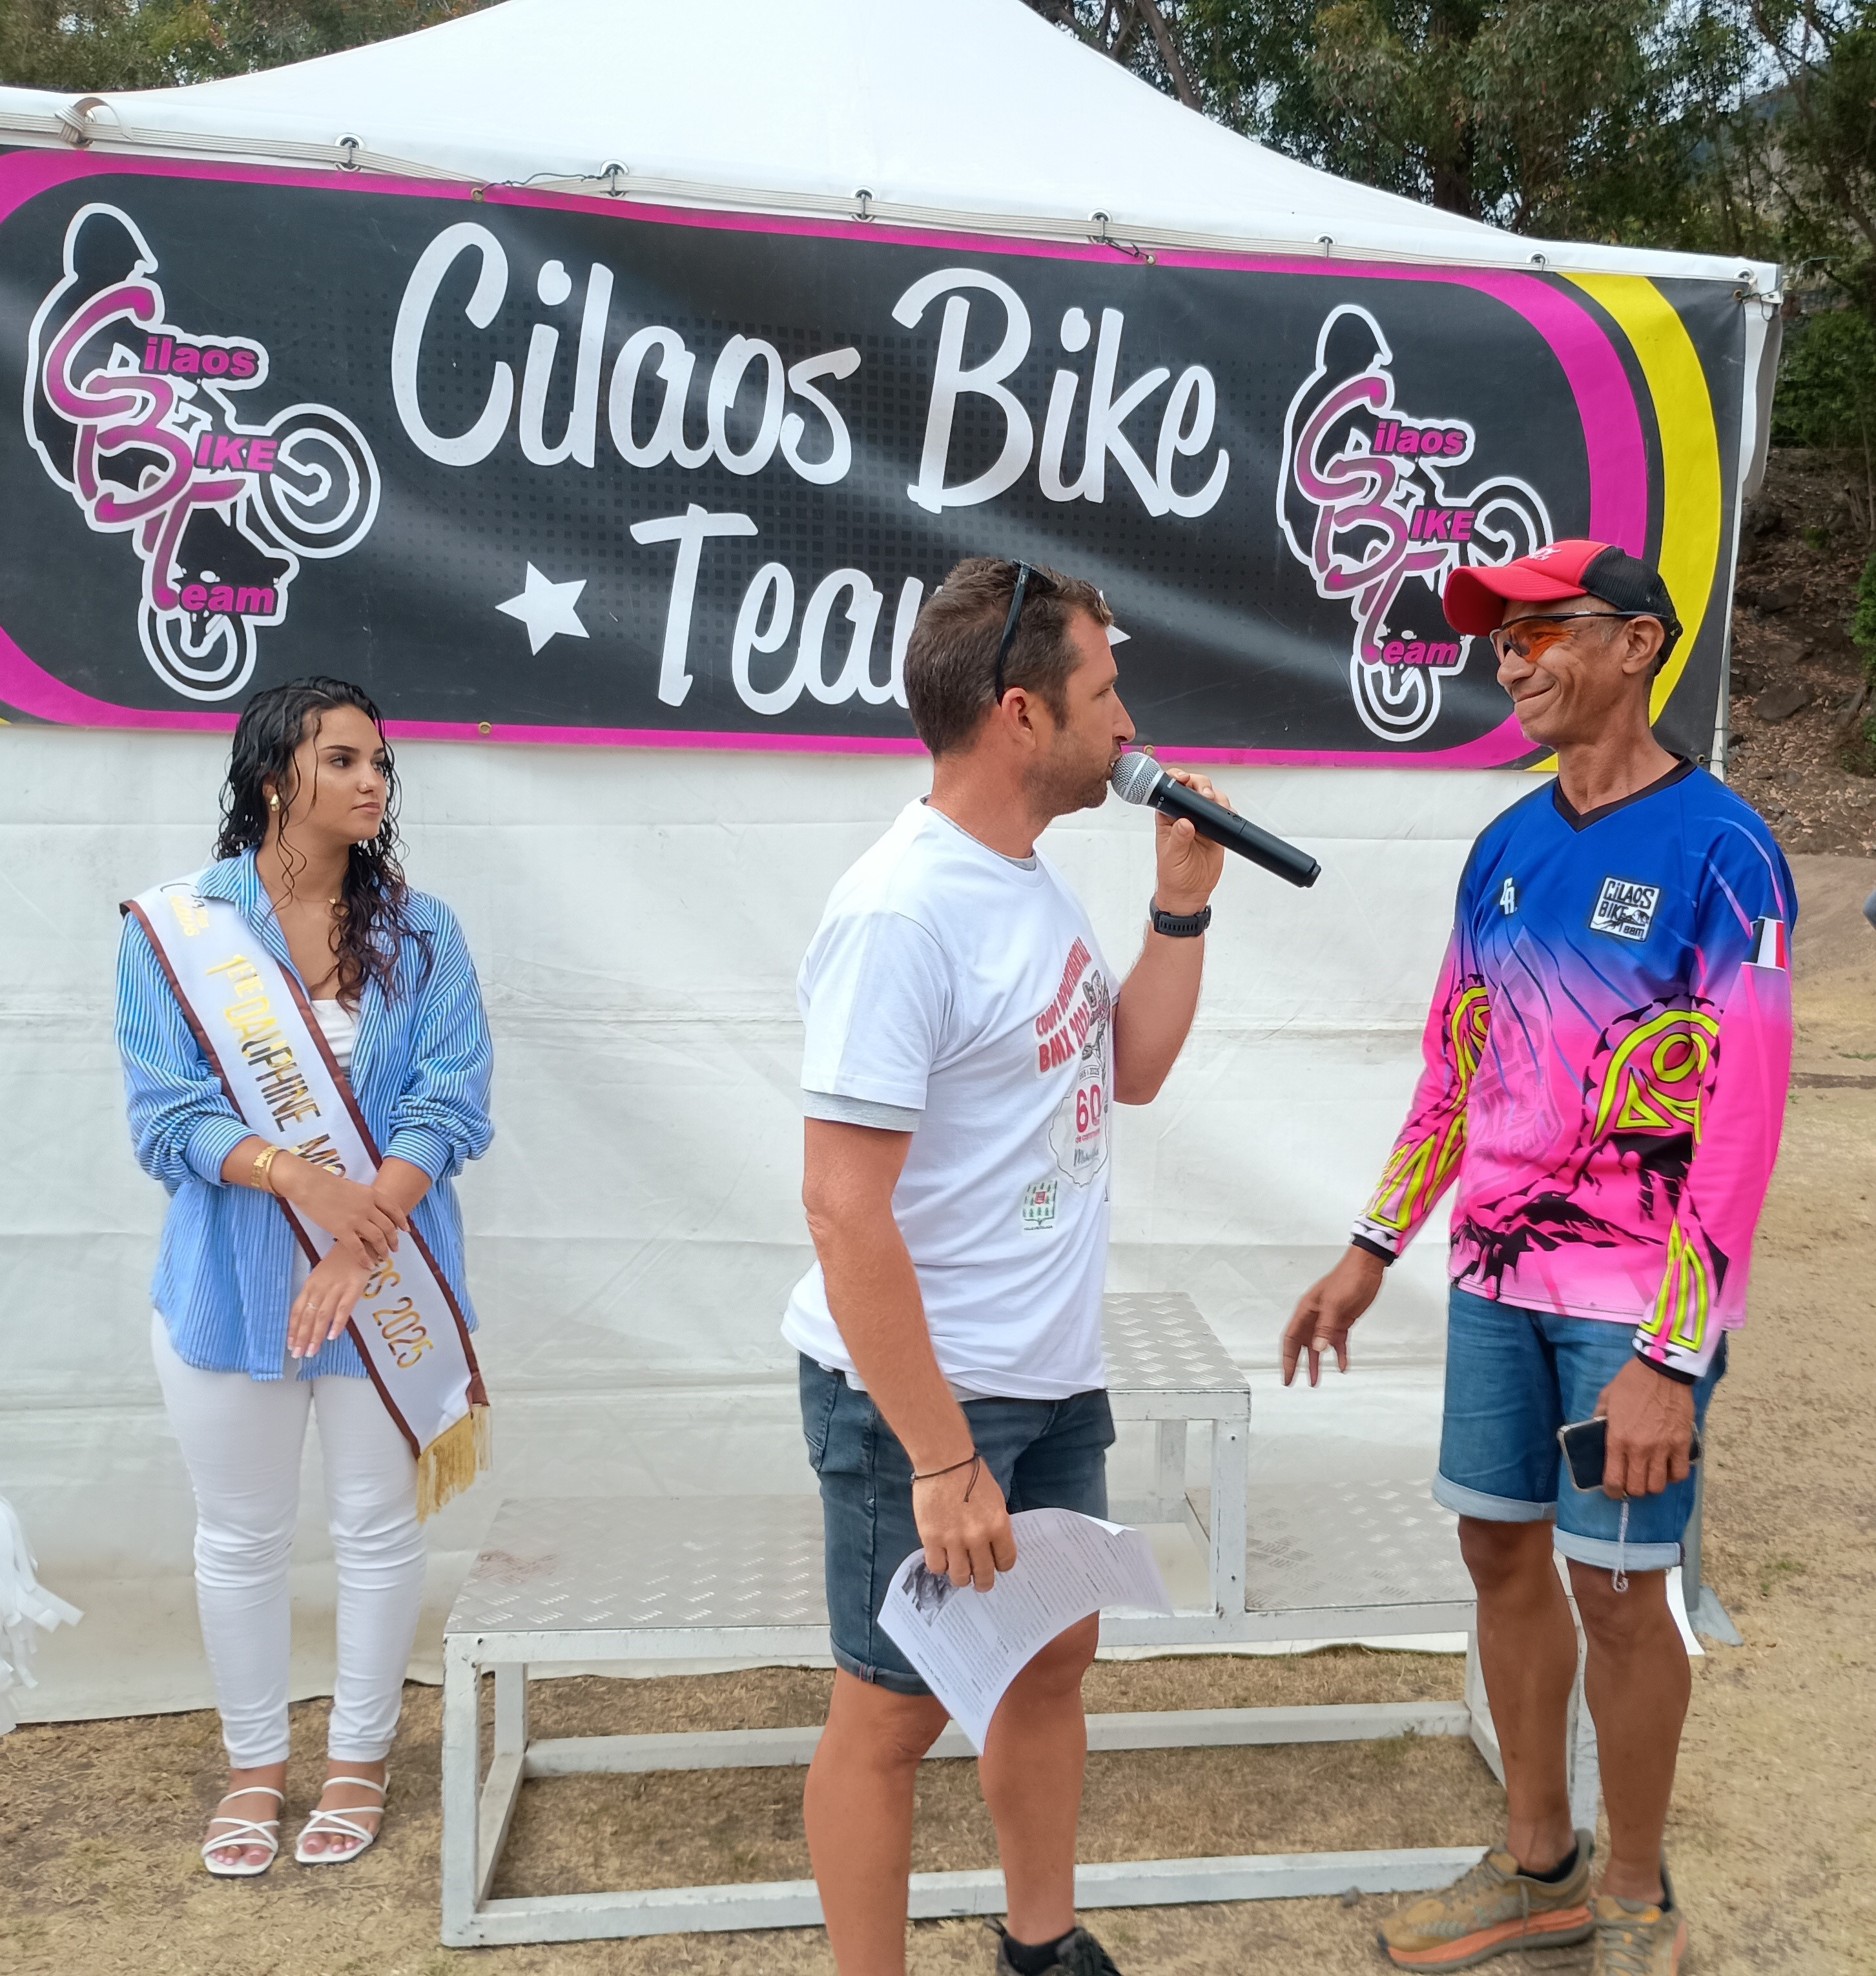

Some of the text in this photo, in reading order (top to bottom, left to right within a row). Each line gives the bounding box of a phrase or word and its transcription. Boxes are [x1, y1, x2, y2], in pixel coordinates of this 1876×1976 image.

[391, 221, 1230, 519] Cilaos Bike
[630, 503, 944, 715] Tea
[1035, 998, 1062, 1037] COUPE
[1038, 1025, 1076, 1073] BMX
[1076, 1084, 1102, 1133] 60
[223, 996, 322, 1133] DAUPHINE
[372, 1296, 434, 1370] 2025
